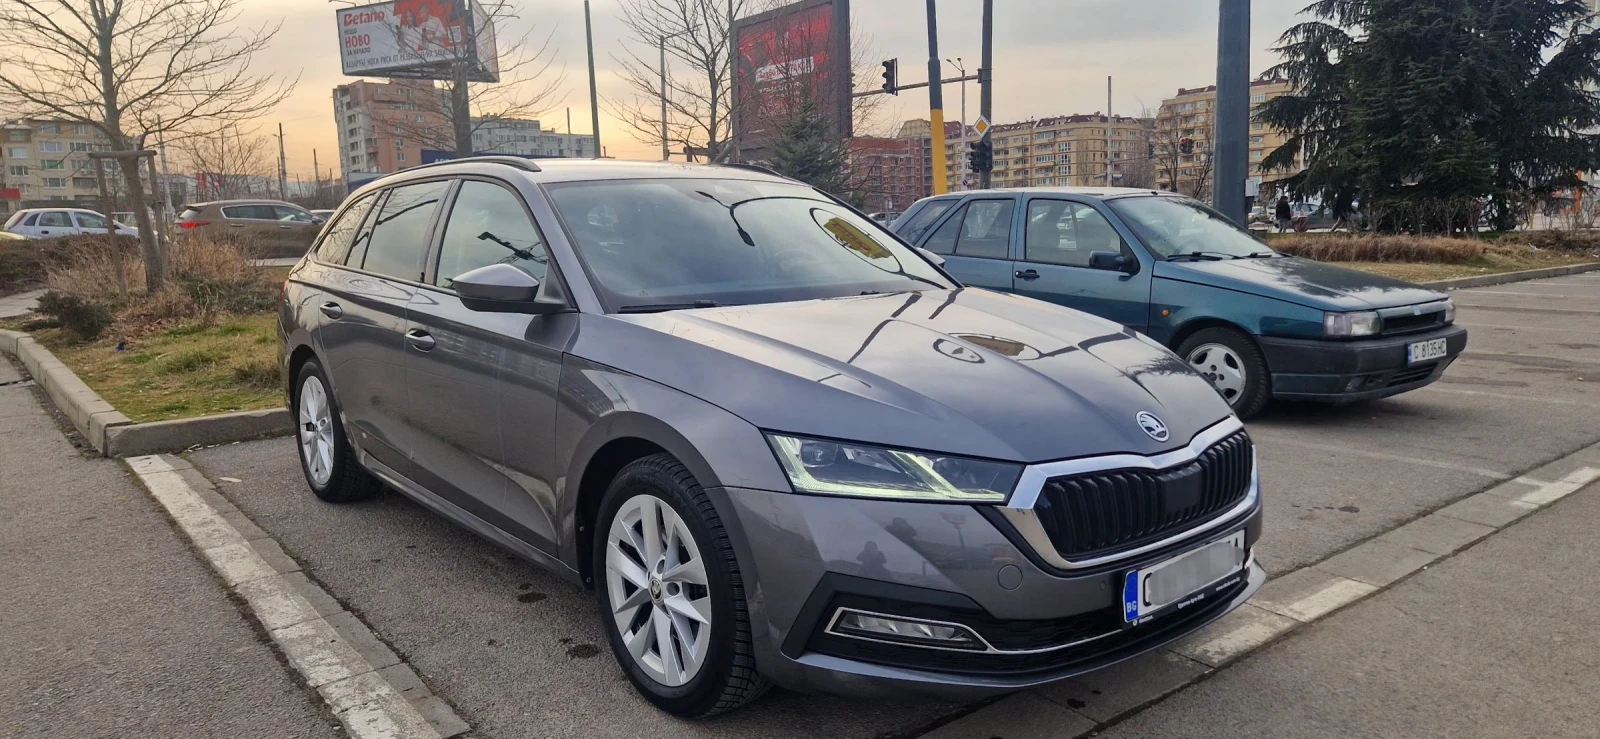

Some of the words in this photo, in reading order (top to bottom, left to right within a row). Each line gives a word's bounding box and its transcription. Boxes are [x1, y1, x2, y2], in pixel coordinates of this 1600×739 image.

[343, 10, 385, 27] Betano
[345, 34, 371, 49] НОВО
[1126, 600, 1137, 612] BG
